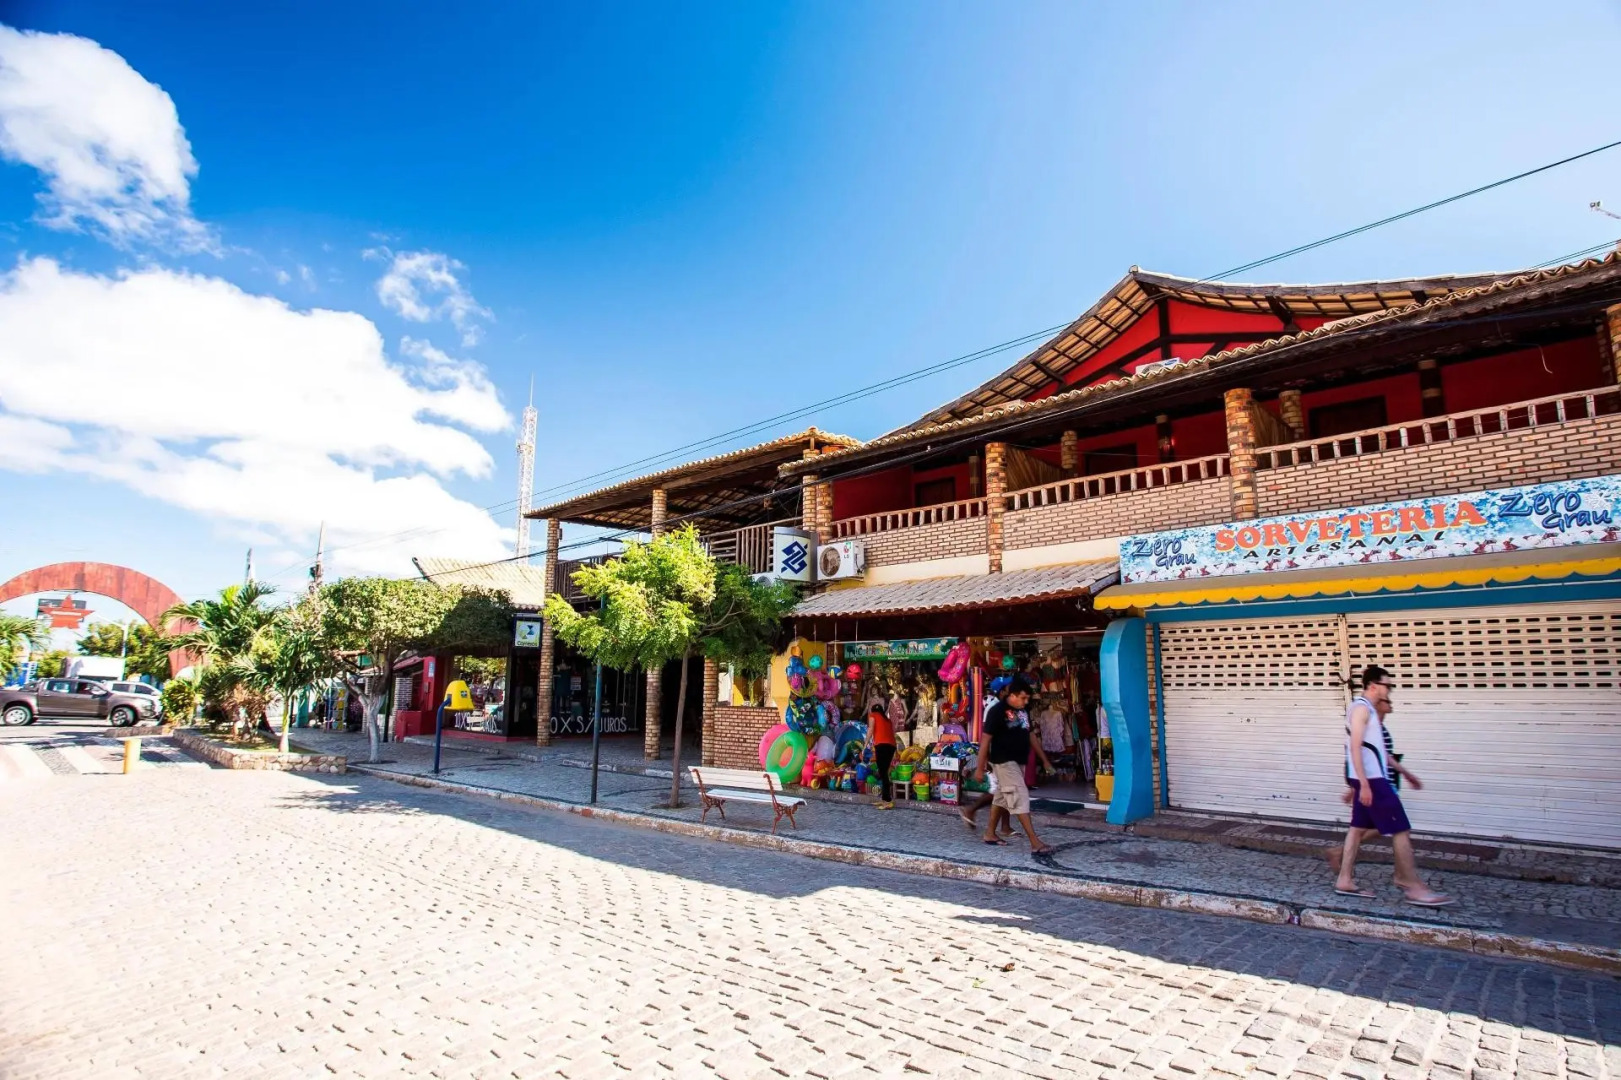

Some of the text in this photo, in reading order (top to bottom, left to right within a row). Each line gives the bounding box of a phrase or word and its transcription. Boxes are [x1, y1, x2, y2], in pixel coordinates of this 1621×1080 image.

[1500, 490, 1581, 518] Zero
[1215, 500, 1488, 552] SORVETERIA
[1541, 509, 1613, 533] Grau
[1132, 538, 1183, 558] Zero
[1155, 552, 1197, 569] Grau
[550, 716, 572, 734] 0X
